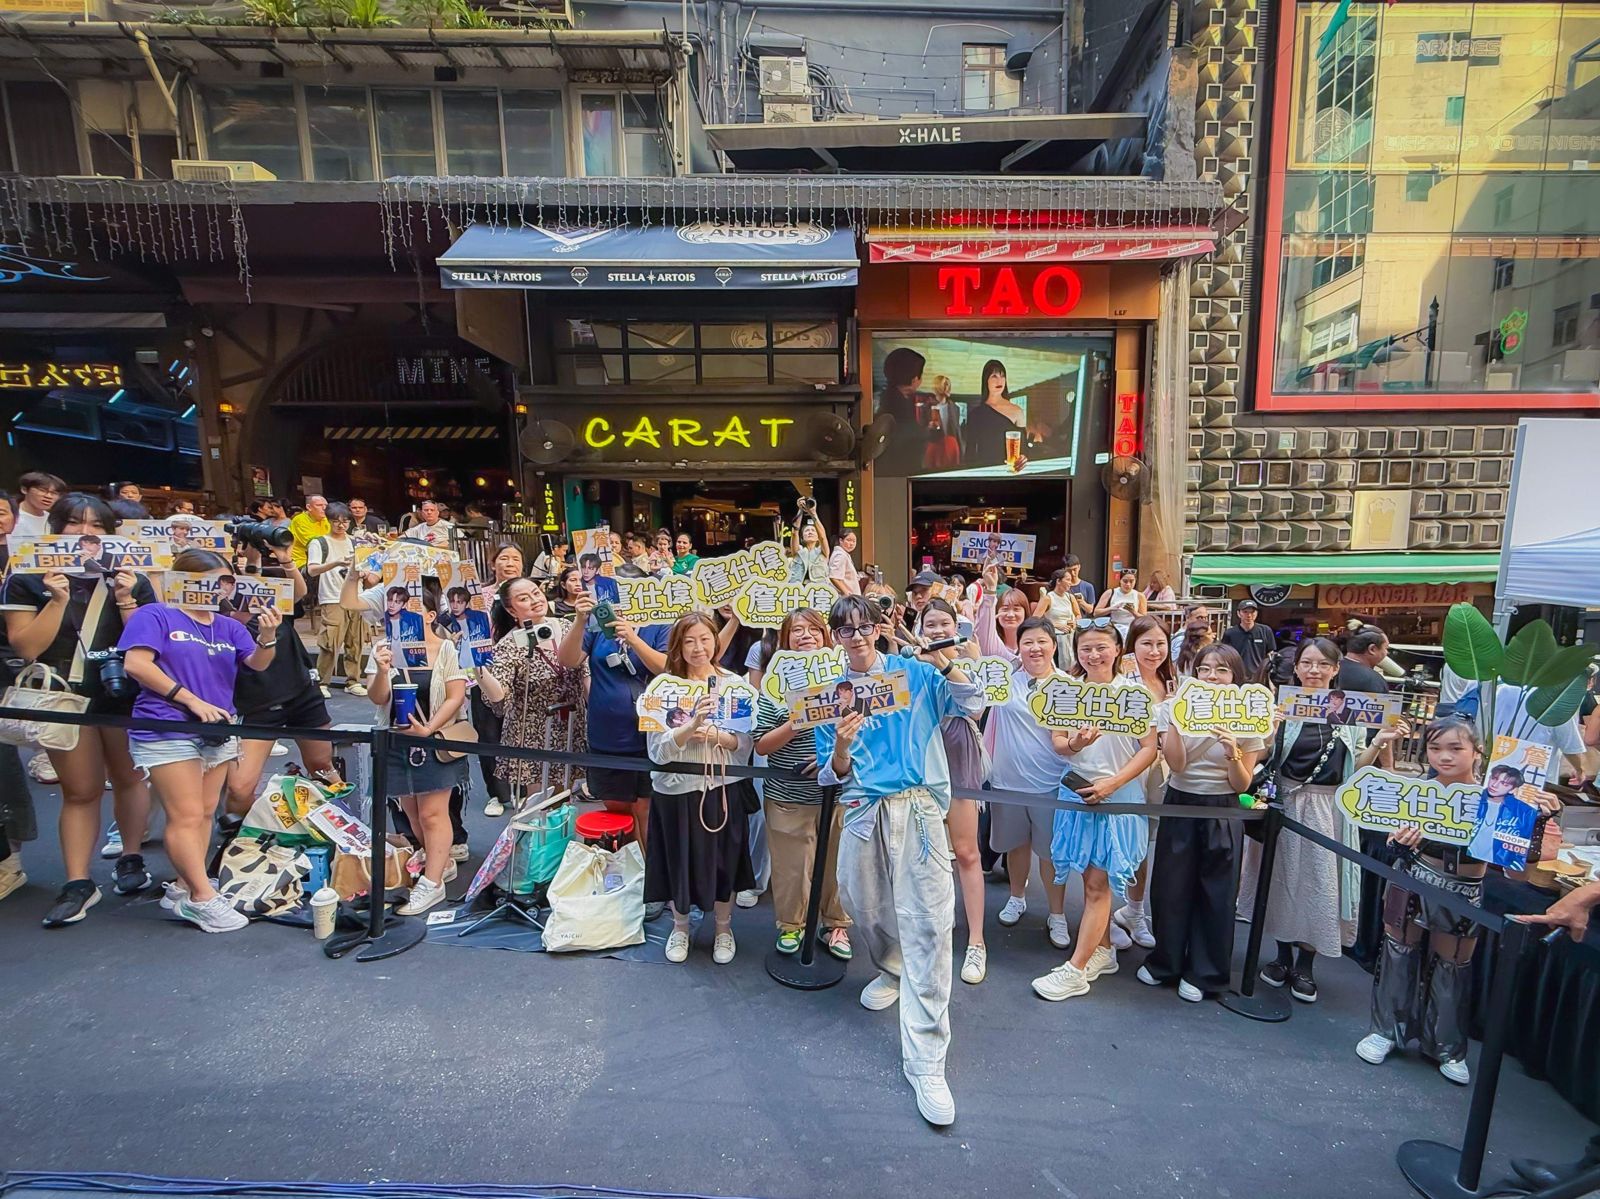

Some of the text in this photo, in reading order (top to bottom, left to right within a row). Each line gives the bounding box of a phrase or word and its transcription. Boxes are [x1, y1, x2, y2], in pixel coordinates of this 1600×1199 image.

[899, 127, 961, 144] X-HALE
[710, 228, 800, 238] ARTOIS
[451, 272, 542, 282] STELLA ARTOIS
[607, 272, 696, 282] STELLA ARTOIS
[760, 272, 847, 282] STELLA ARTOIS
[938, 266, 1082, 316] TAO
[750, 326, 810, 342] ATOIS
[584, 415, 795, 448] CARAT
[1117, 393, 1138, 457] TAO
[544, 483, 555, 525] INDIAN
[846, 480, 855, 522] INDIAN
[141, 525, 213, 537] SNPY
[54, 541, 131, 554] HAPY
[968, 537, 1016, 550] SNPY
[38, 554, 149, 568] BIRAY
[696, 546, 784, 597] 詹仕偉
[199, 580, 258, 595] HAPY
[711, 586, 741, 605] Snoo
[1325, 582, 1469, 606] CORNER BAR
[185, 592, 272, 608] BIRAY
[745, 581, 834, 614] 詹仕偉
[1256, 591, 1284, 602] ISLAND
[622, 609, 679, 623] oopy Chan
[750, 614, 785, 625] Snoop
[819, 682, 876, 705] HAPY
[1042, 678, 1152, 720] 詹仕偉
[807, 696, 889, 722] BIRAY
[1182, 684, 1271, 721] 詹仕偉
[1308, 694, 1369, 710] HAPY
[1295, 705, 1380, 722] BIRAY
[1096, 719, 1129, 734] Chan
[1188, 721, 1256, 733] Snooy Chan
[1423, 822, 1467, 839] Chan
[1494, 832, 1528, 846] SNOOPY
[1502, 842, 1526, 855] 0108
